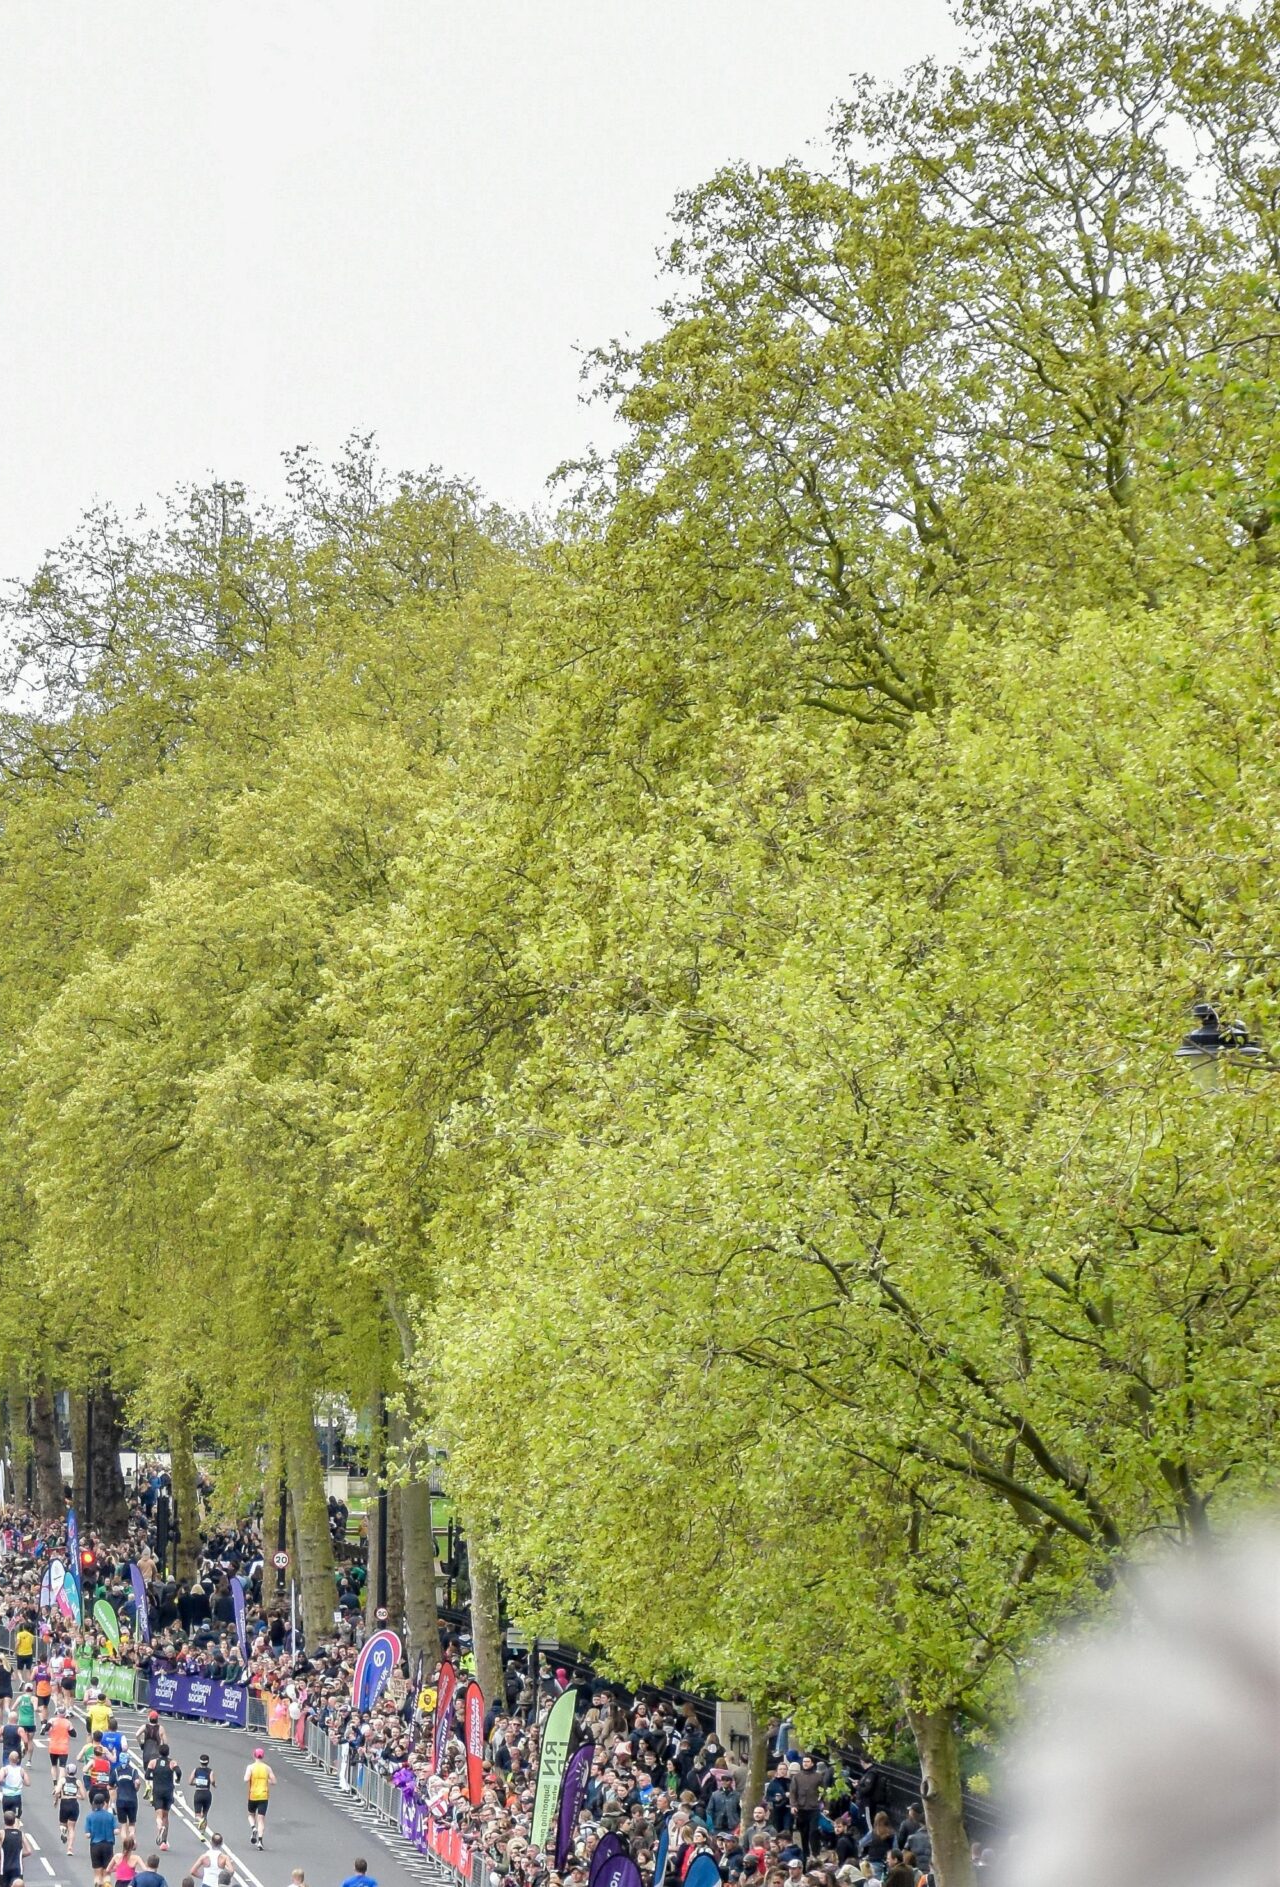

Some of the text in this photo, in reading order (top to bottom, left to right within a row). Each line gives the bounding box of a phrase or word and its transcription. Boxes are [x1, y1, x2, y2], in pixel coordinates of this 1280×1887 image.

[275, 1556, 287, 1564] 20
[381, 1666, 389, 1680] UK
[155, 1688, 173, 1700] society
[191, 1681, 211, 1696] epilepsy
[224, 1687, 242, 1702] epilepsy
[188, 1693, 206, 1706] society
[222, 1698, 238, 1712] society
